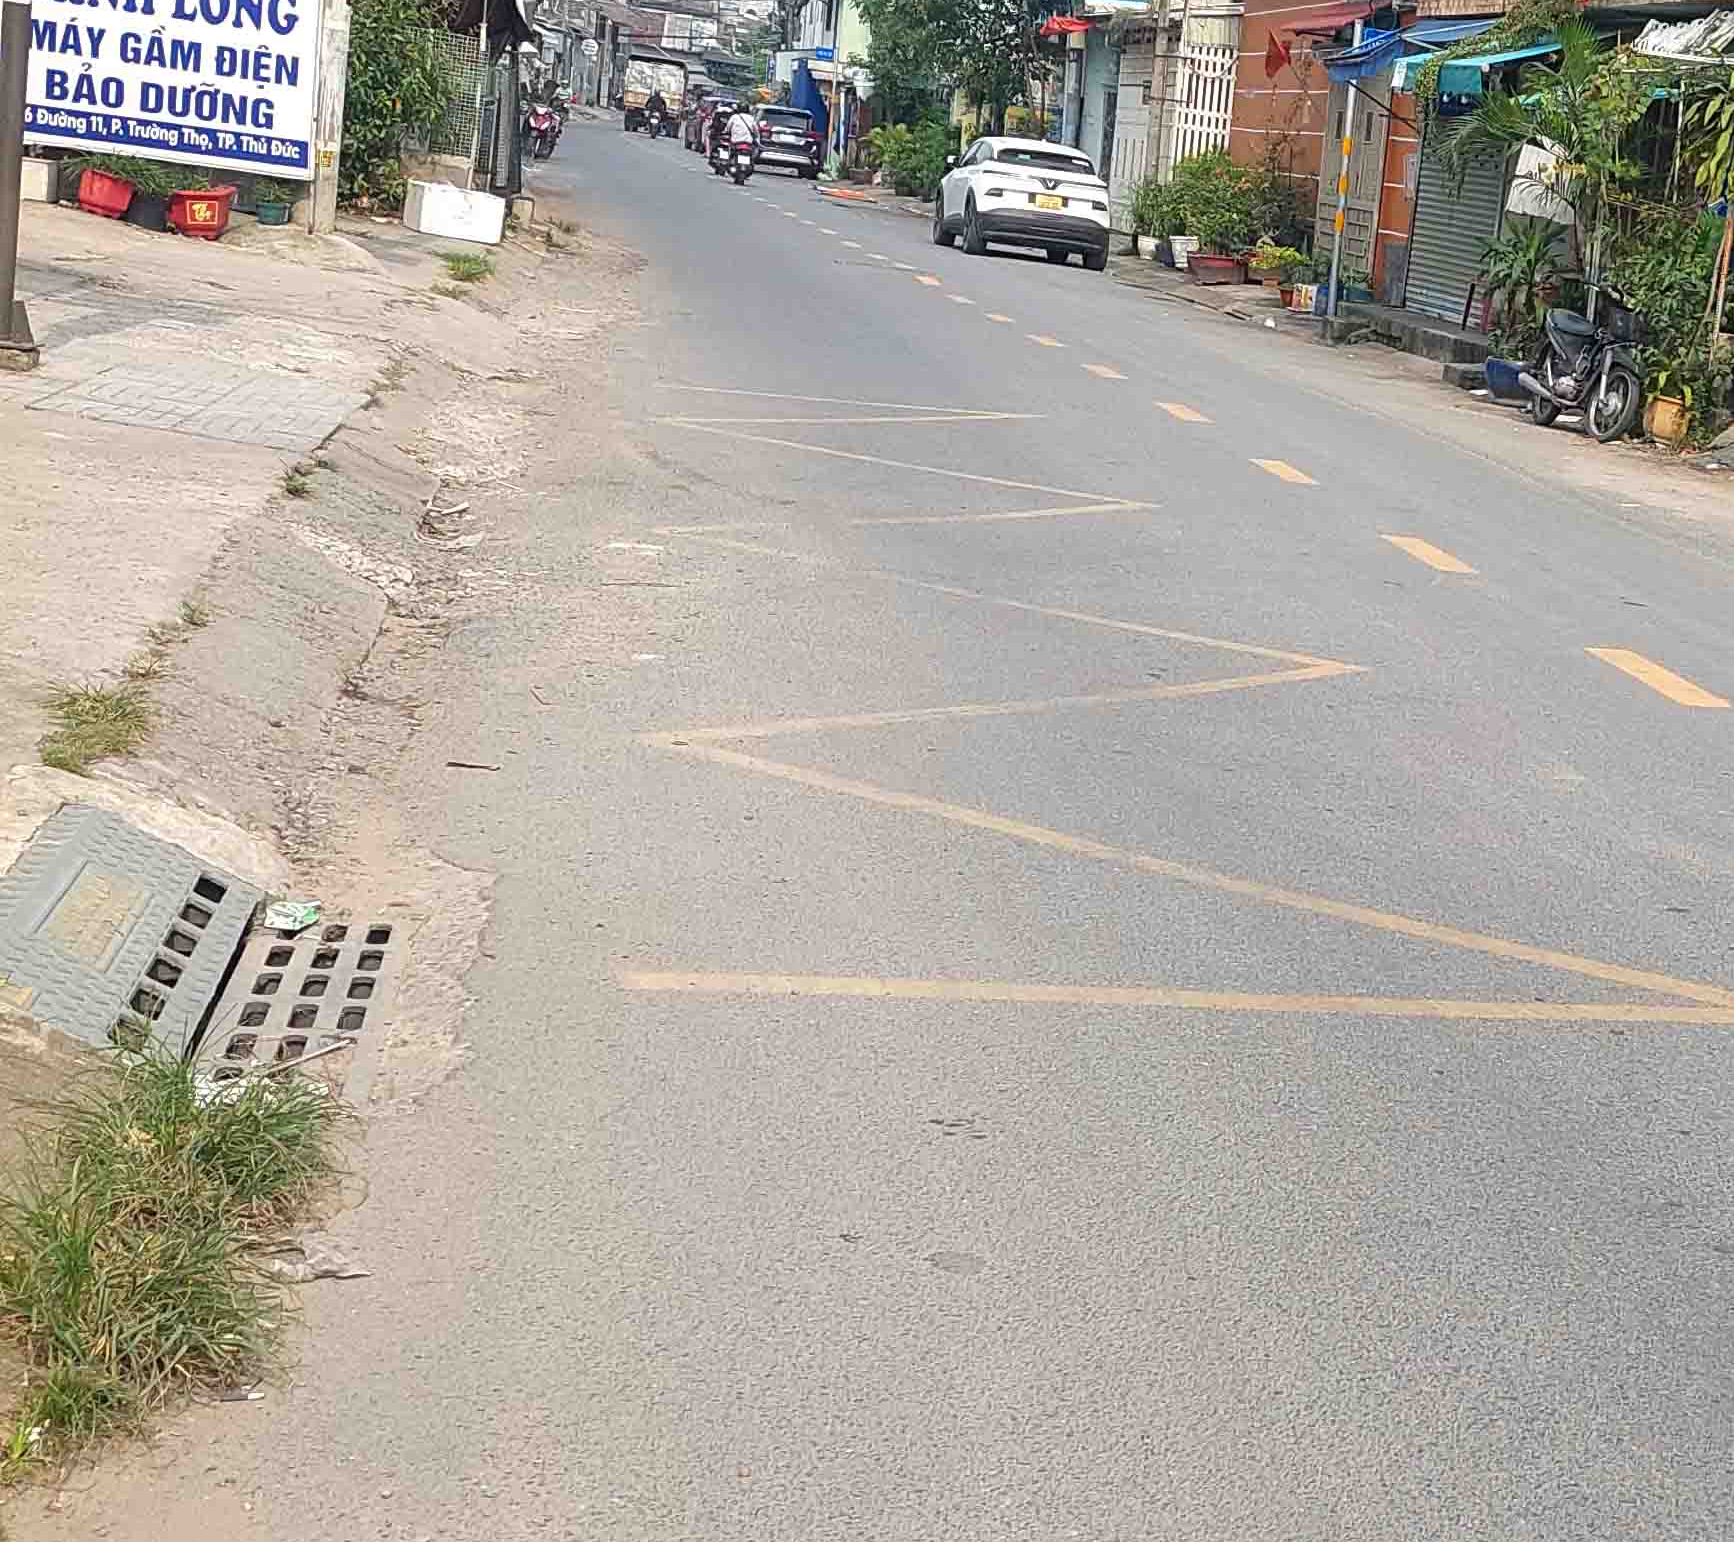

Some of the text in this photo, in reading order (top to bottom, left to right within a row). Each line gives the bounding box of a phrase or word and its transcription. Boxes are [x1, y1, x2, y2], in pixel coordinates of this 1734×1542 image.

[31, 17, 299, 89] MÁY GẦM ĐIỆN
[45, 63, 275, 130] BẢO DƯỠNG
[36, 108, 87, 134] Đường
[127, 120, 179, 146] Trường
[216, 132, 237, 151] TP.
[240, 136, 267, 154] Thủ
[271, 140, 300, 159] Đức
